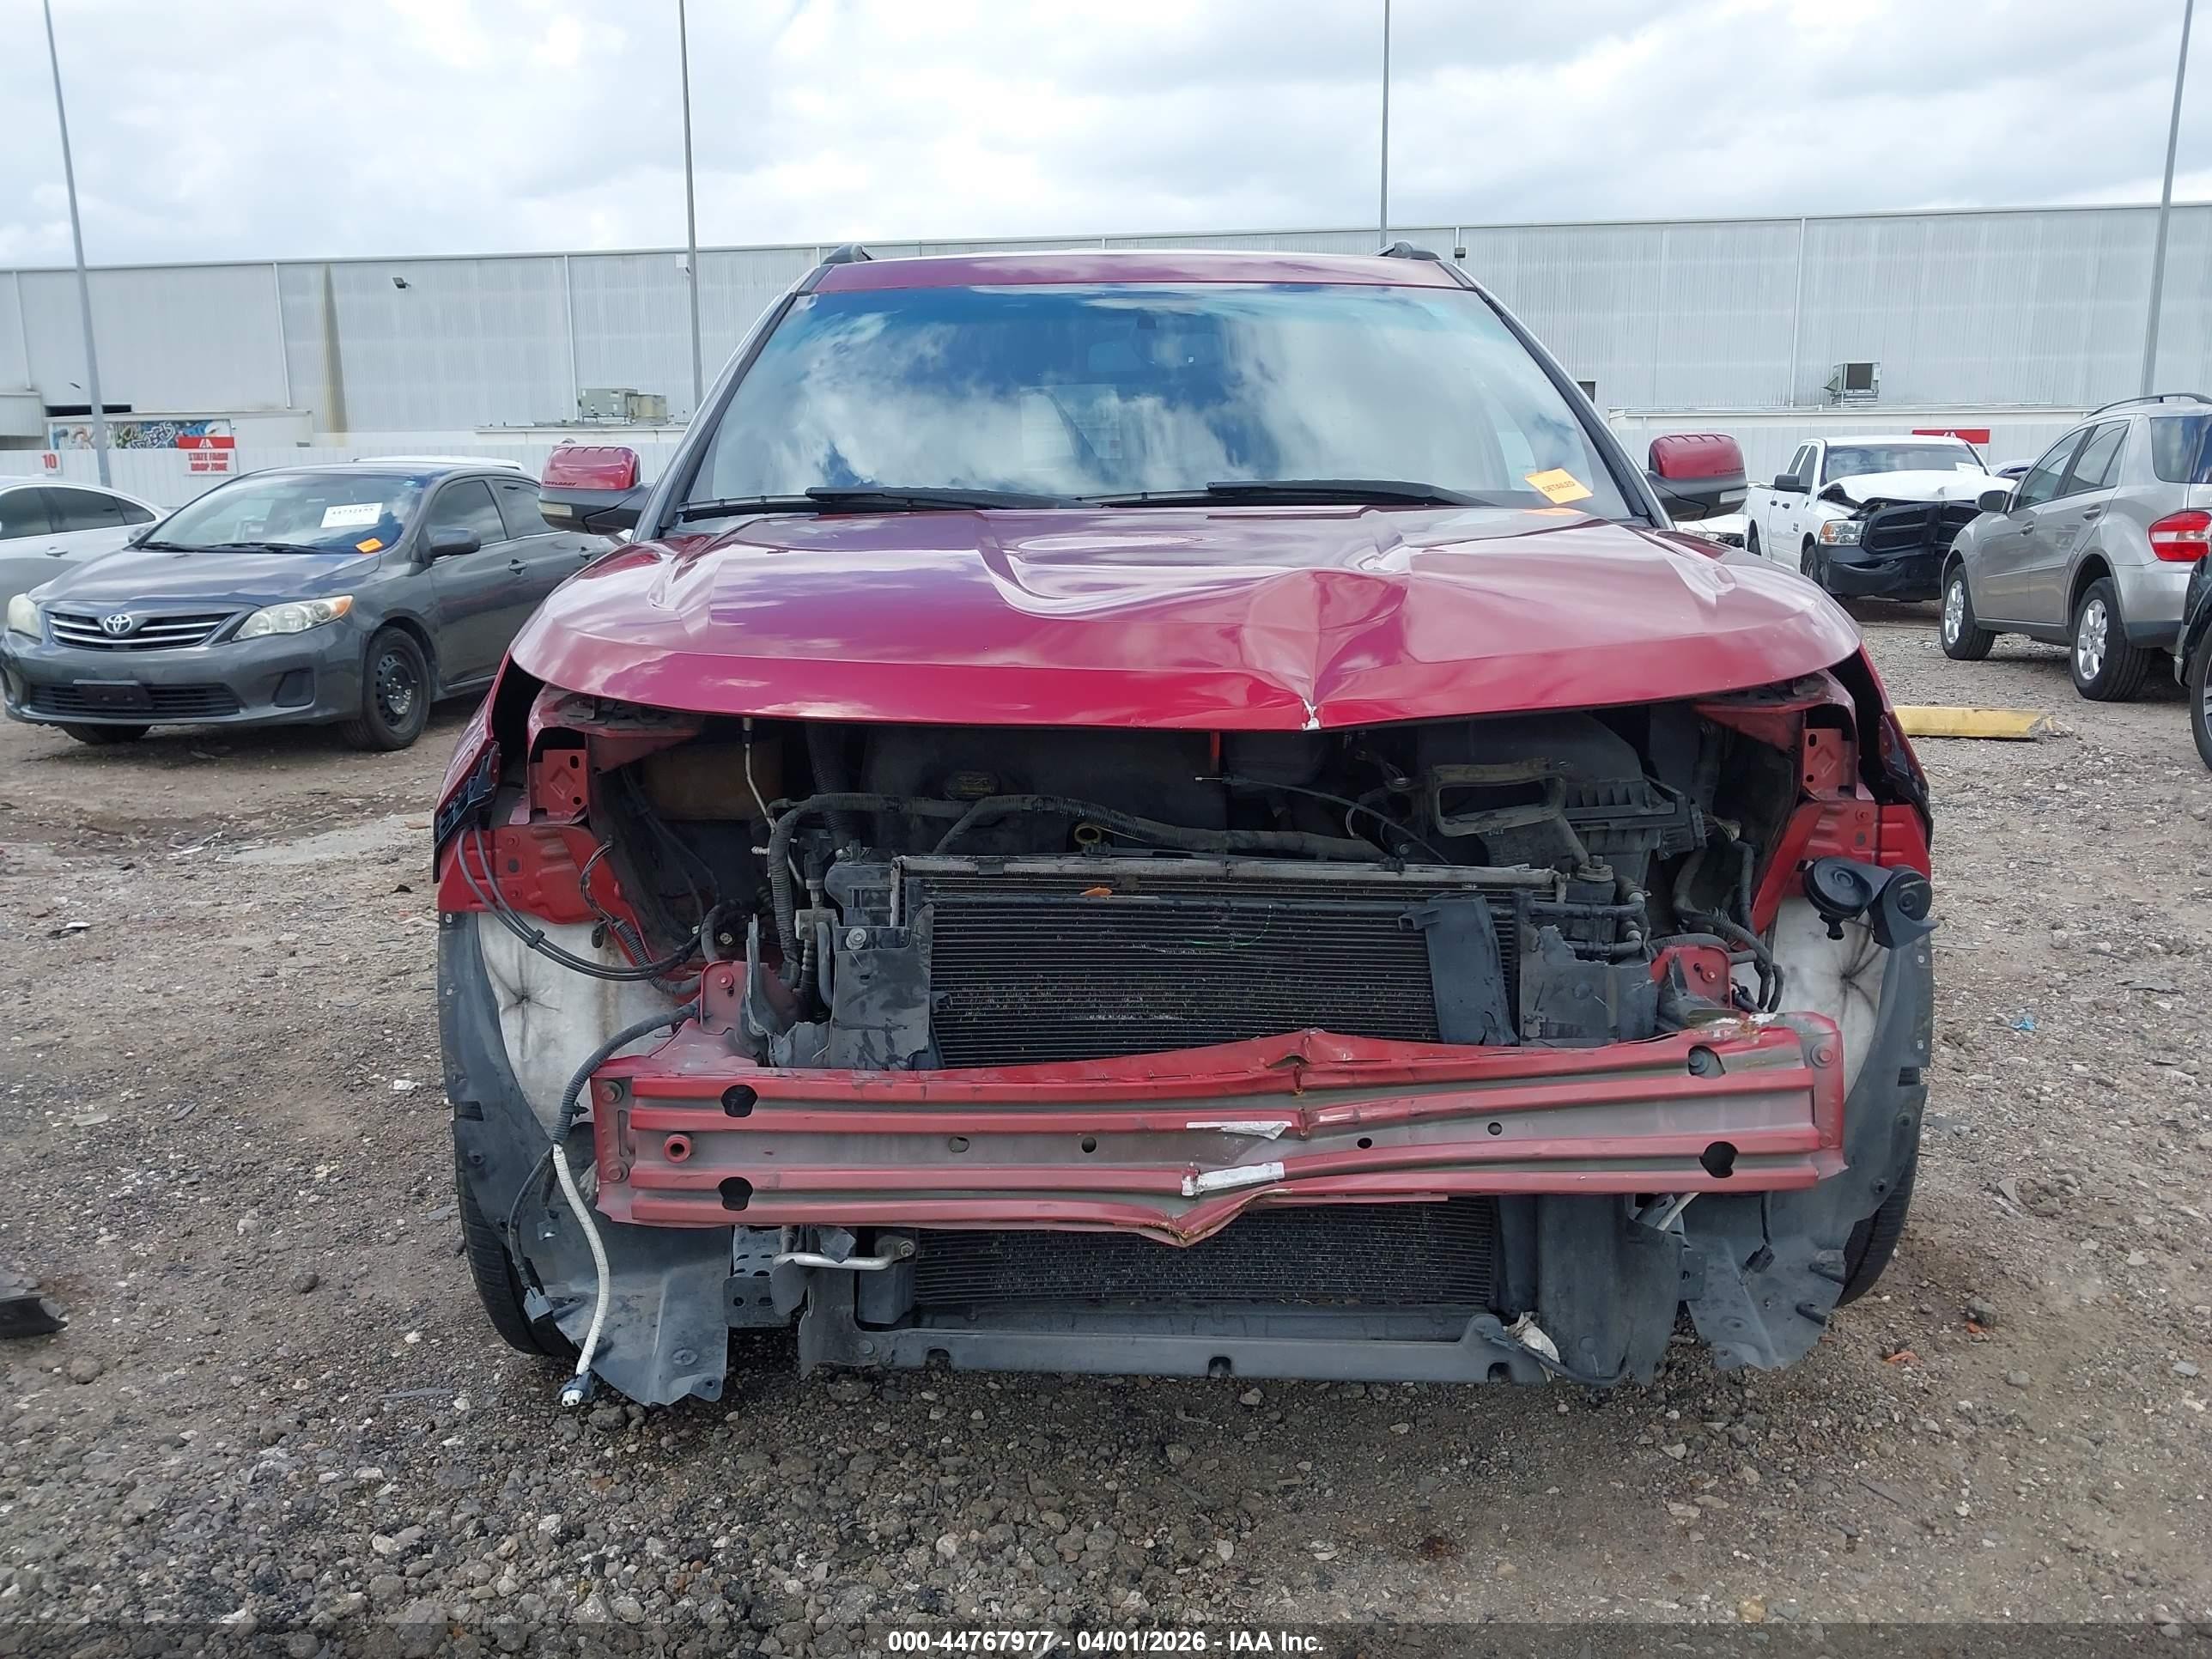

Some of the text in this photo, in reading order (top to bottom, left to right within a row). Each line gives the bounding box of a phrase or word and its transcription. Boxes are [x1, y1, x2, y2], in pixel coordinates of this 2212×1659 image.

[41, 453, 57, 469] 10
[191, 463, 210, 471] DROP
[1541, 480, 1576, 493] DETAILED
